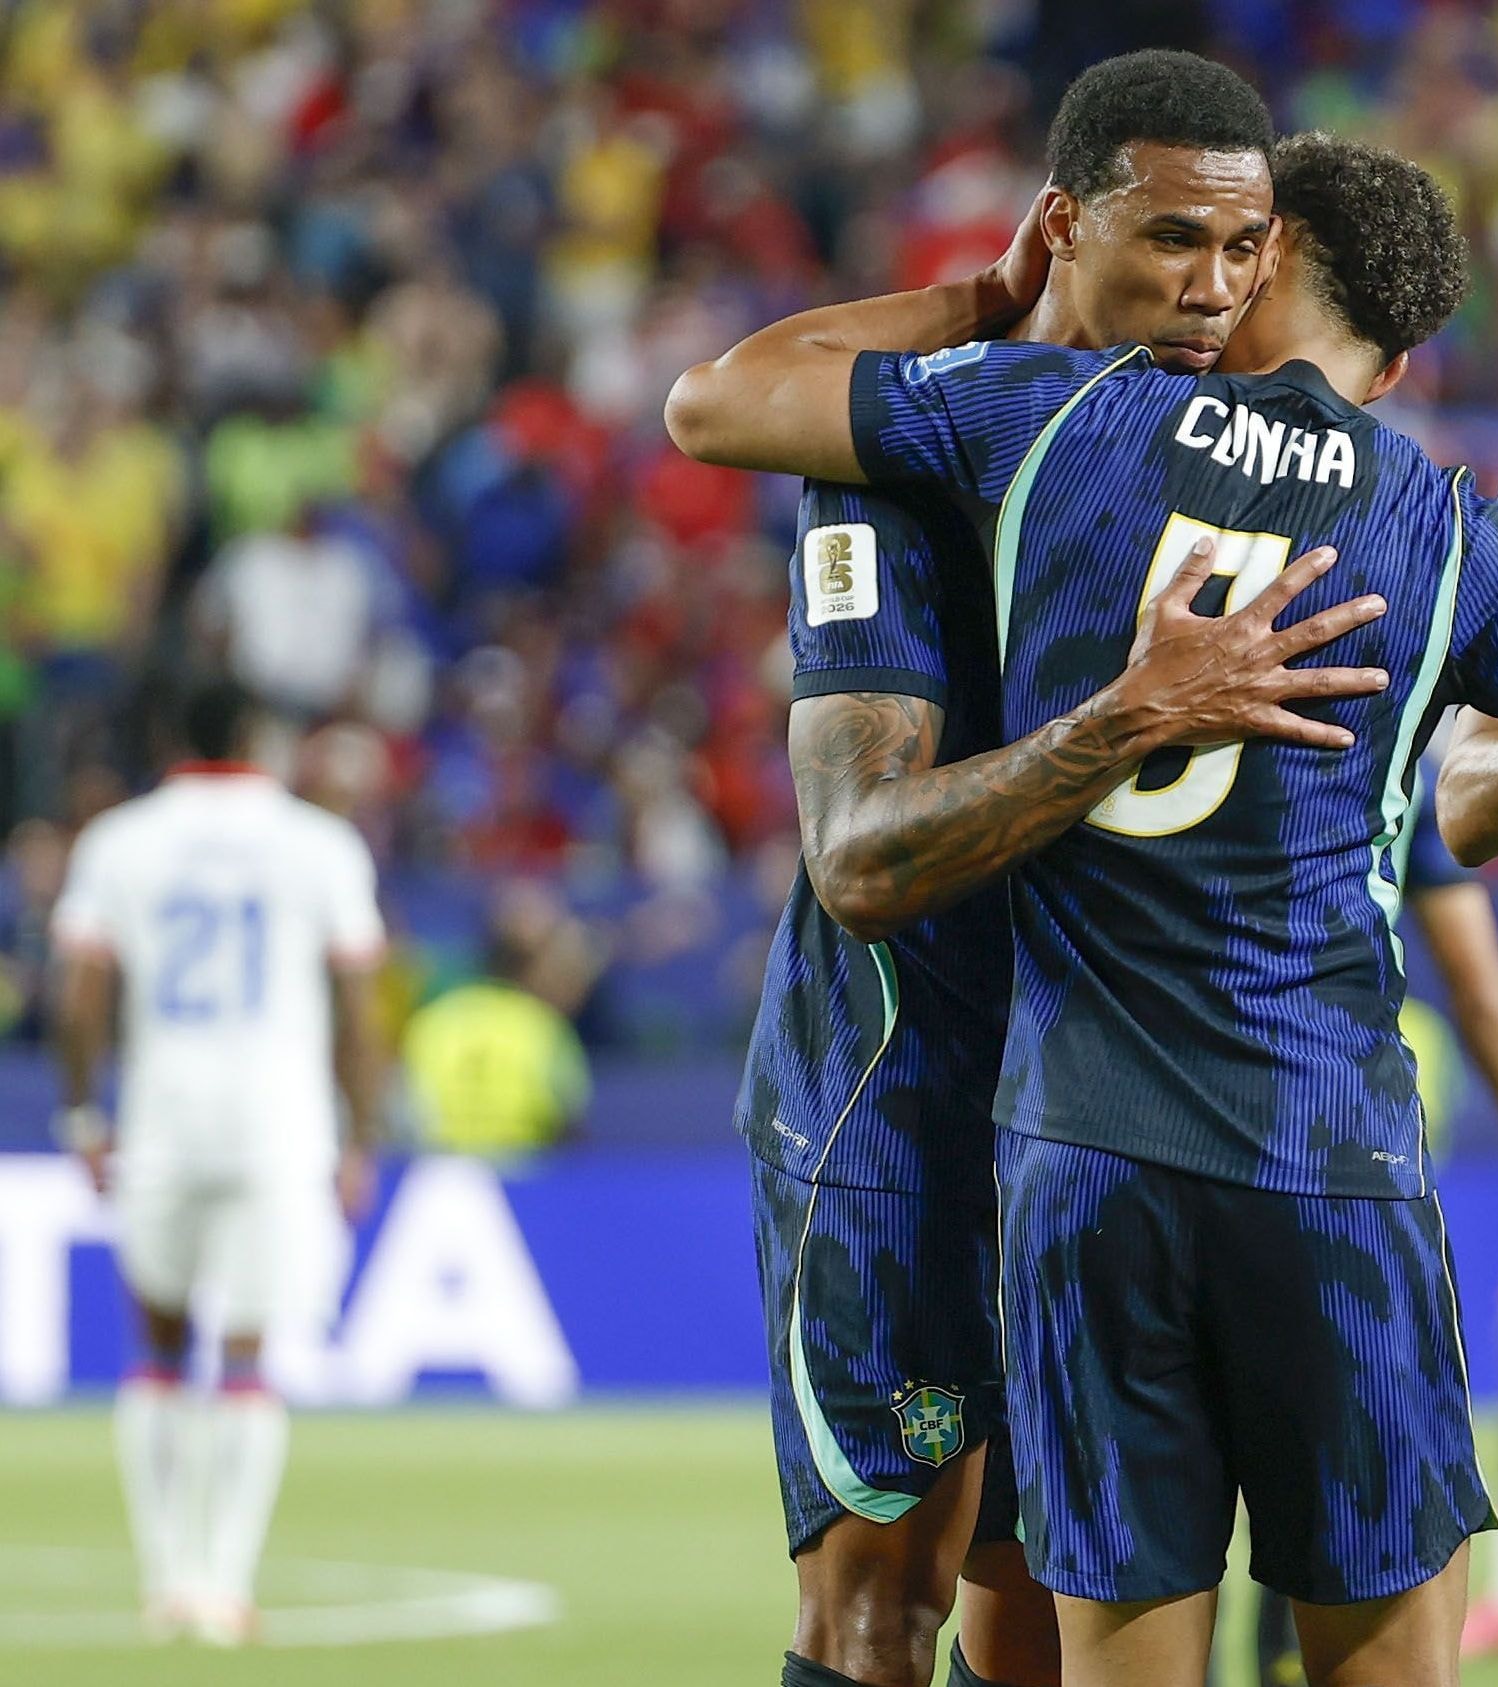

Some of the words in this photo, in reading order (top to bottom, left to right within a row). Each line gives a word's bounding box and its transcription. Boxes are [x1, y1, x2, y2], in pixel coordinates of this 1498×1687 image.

[1174, 395, 1356, 489] CUNHA
[156, 895, 267, 1022] 21
[0, 1152, 582, 1406] TA
[919, 1418, 944, 1431] CBF
